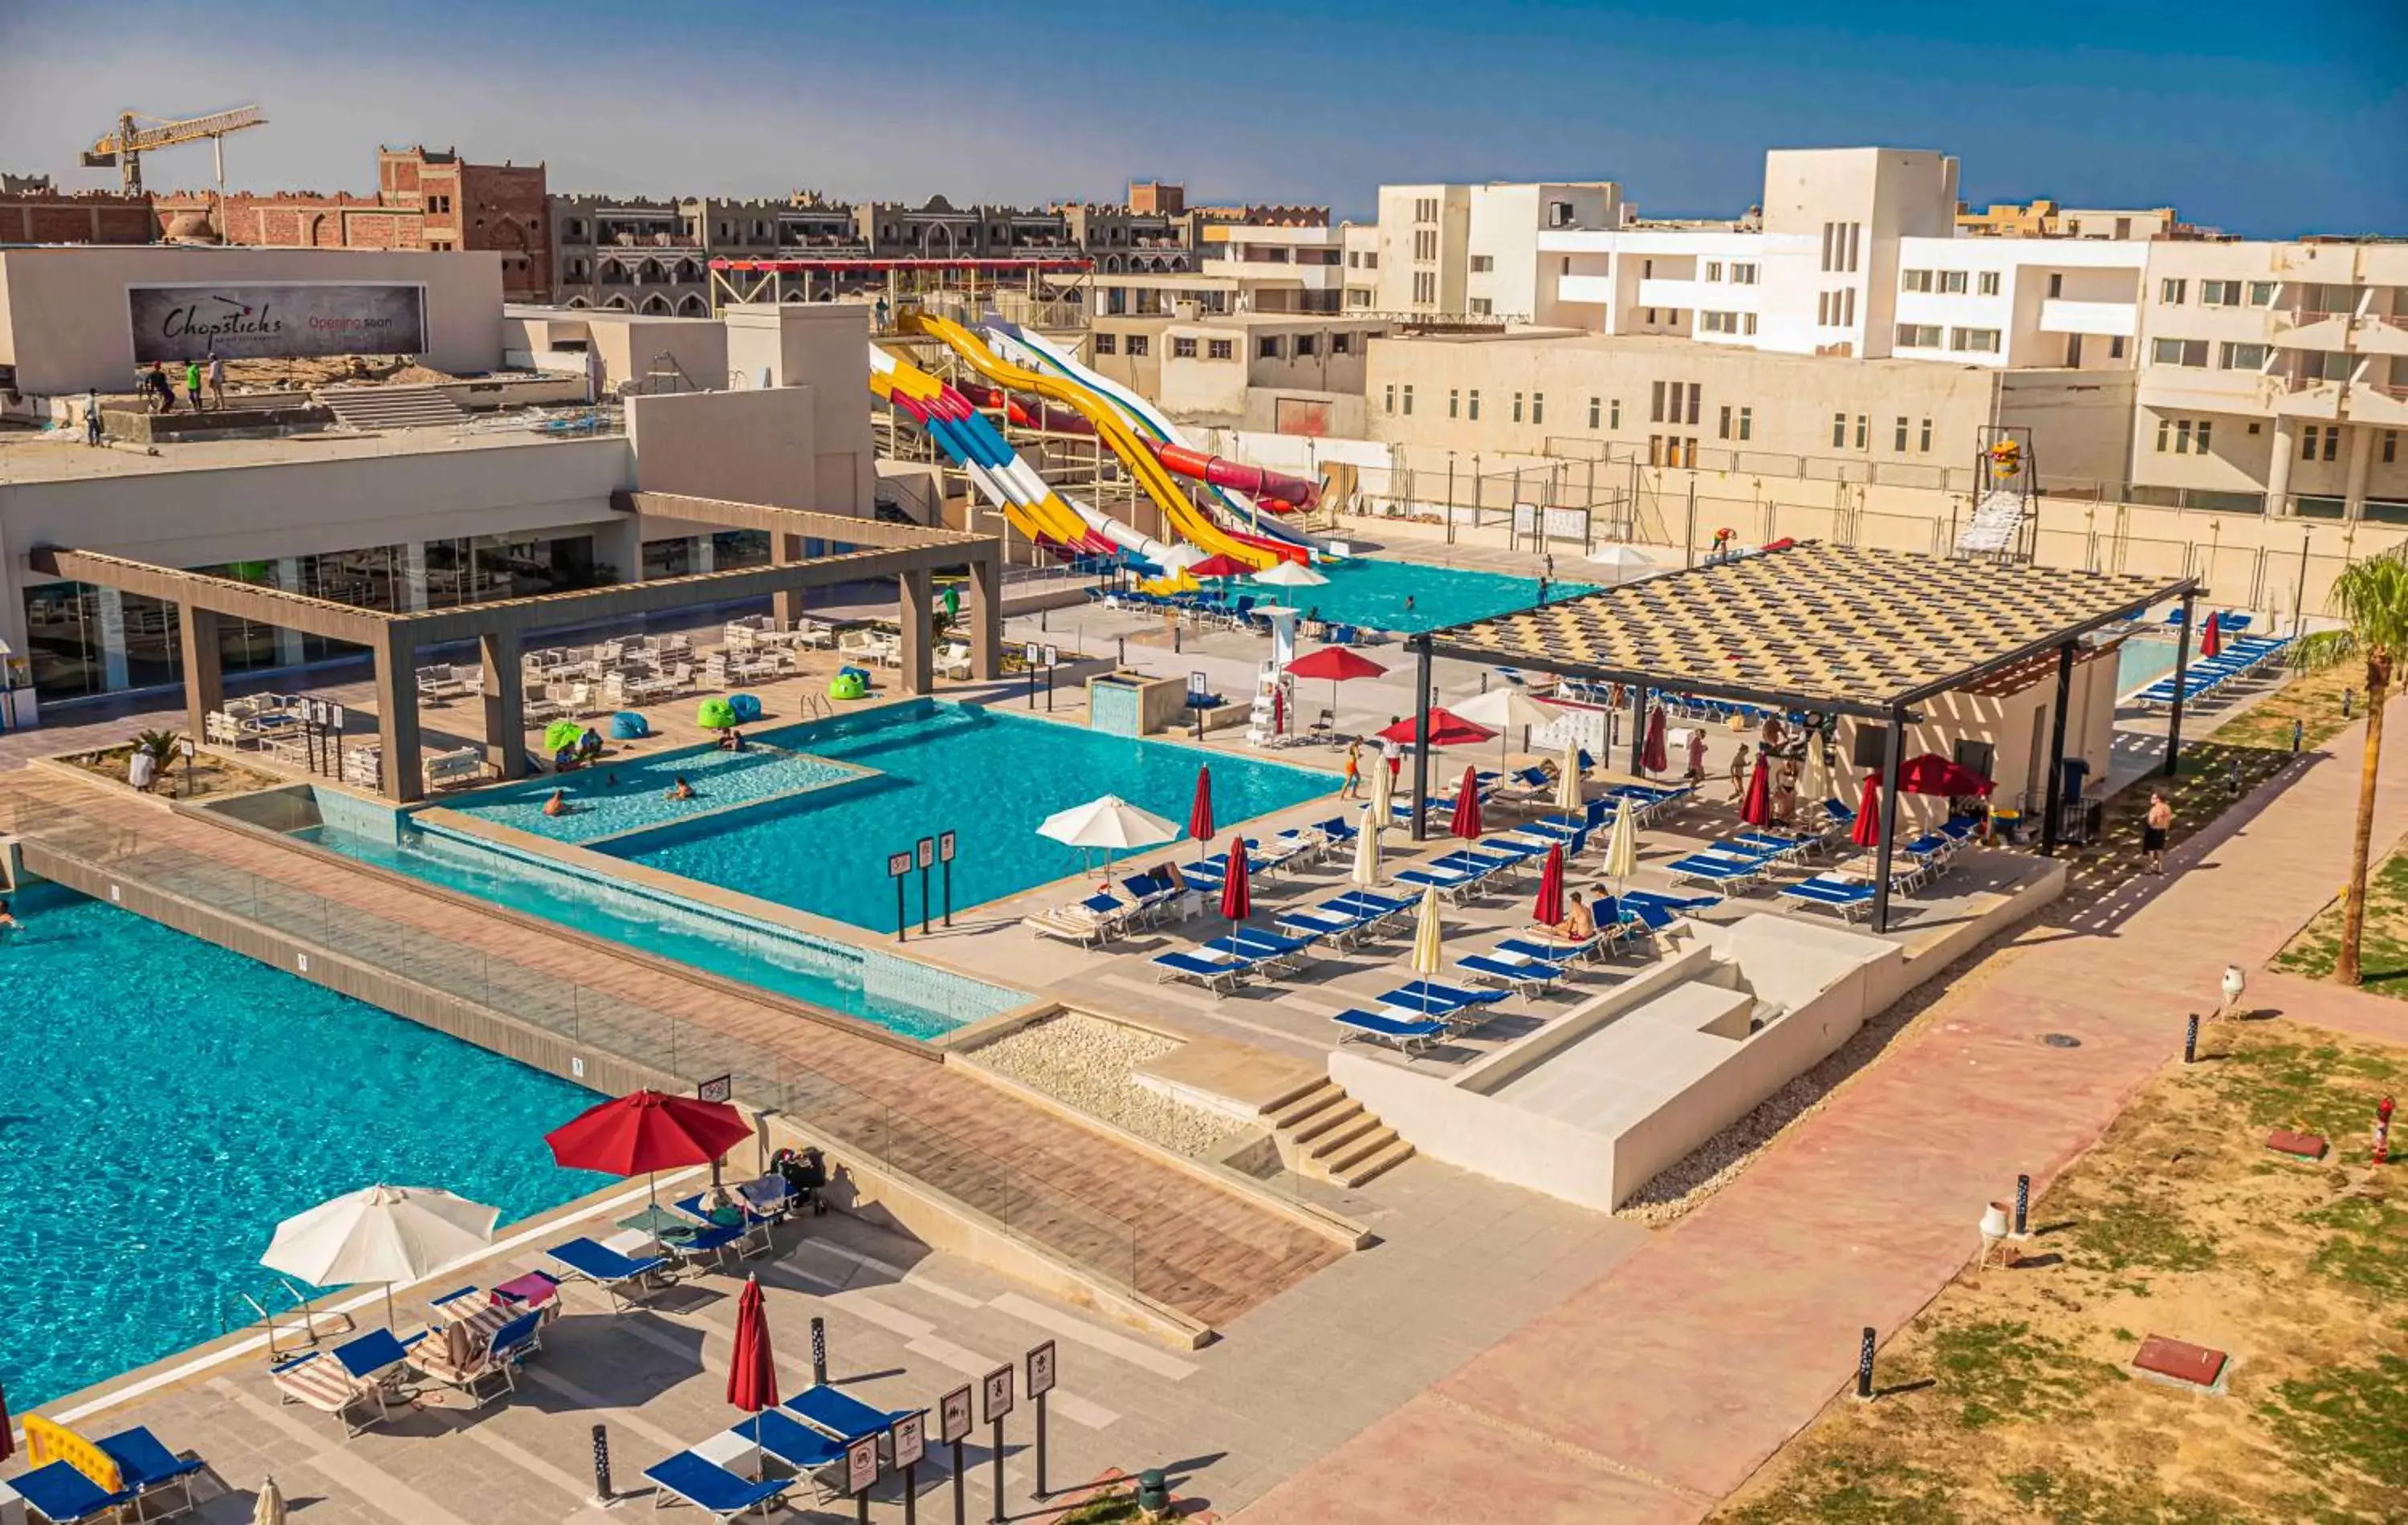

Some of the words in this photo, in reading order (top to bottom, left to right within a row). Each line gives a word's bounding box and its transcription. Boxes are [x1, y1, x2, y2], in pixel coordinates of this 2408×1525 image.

[163, 303, 282, 351] Chopsticks
[309, 315, 360, 331] Opening
[364, 318, 393, 328] soon
